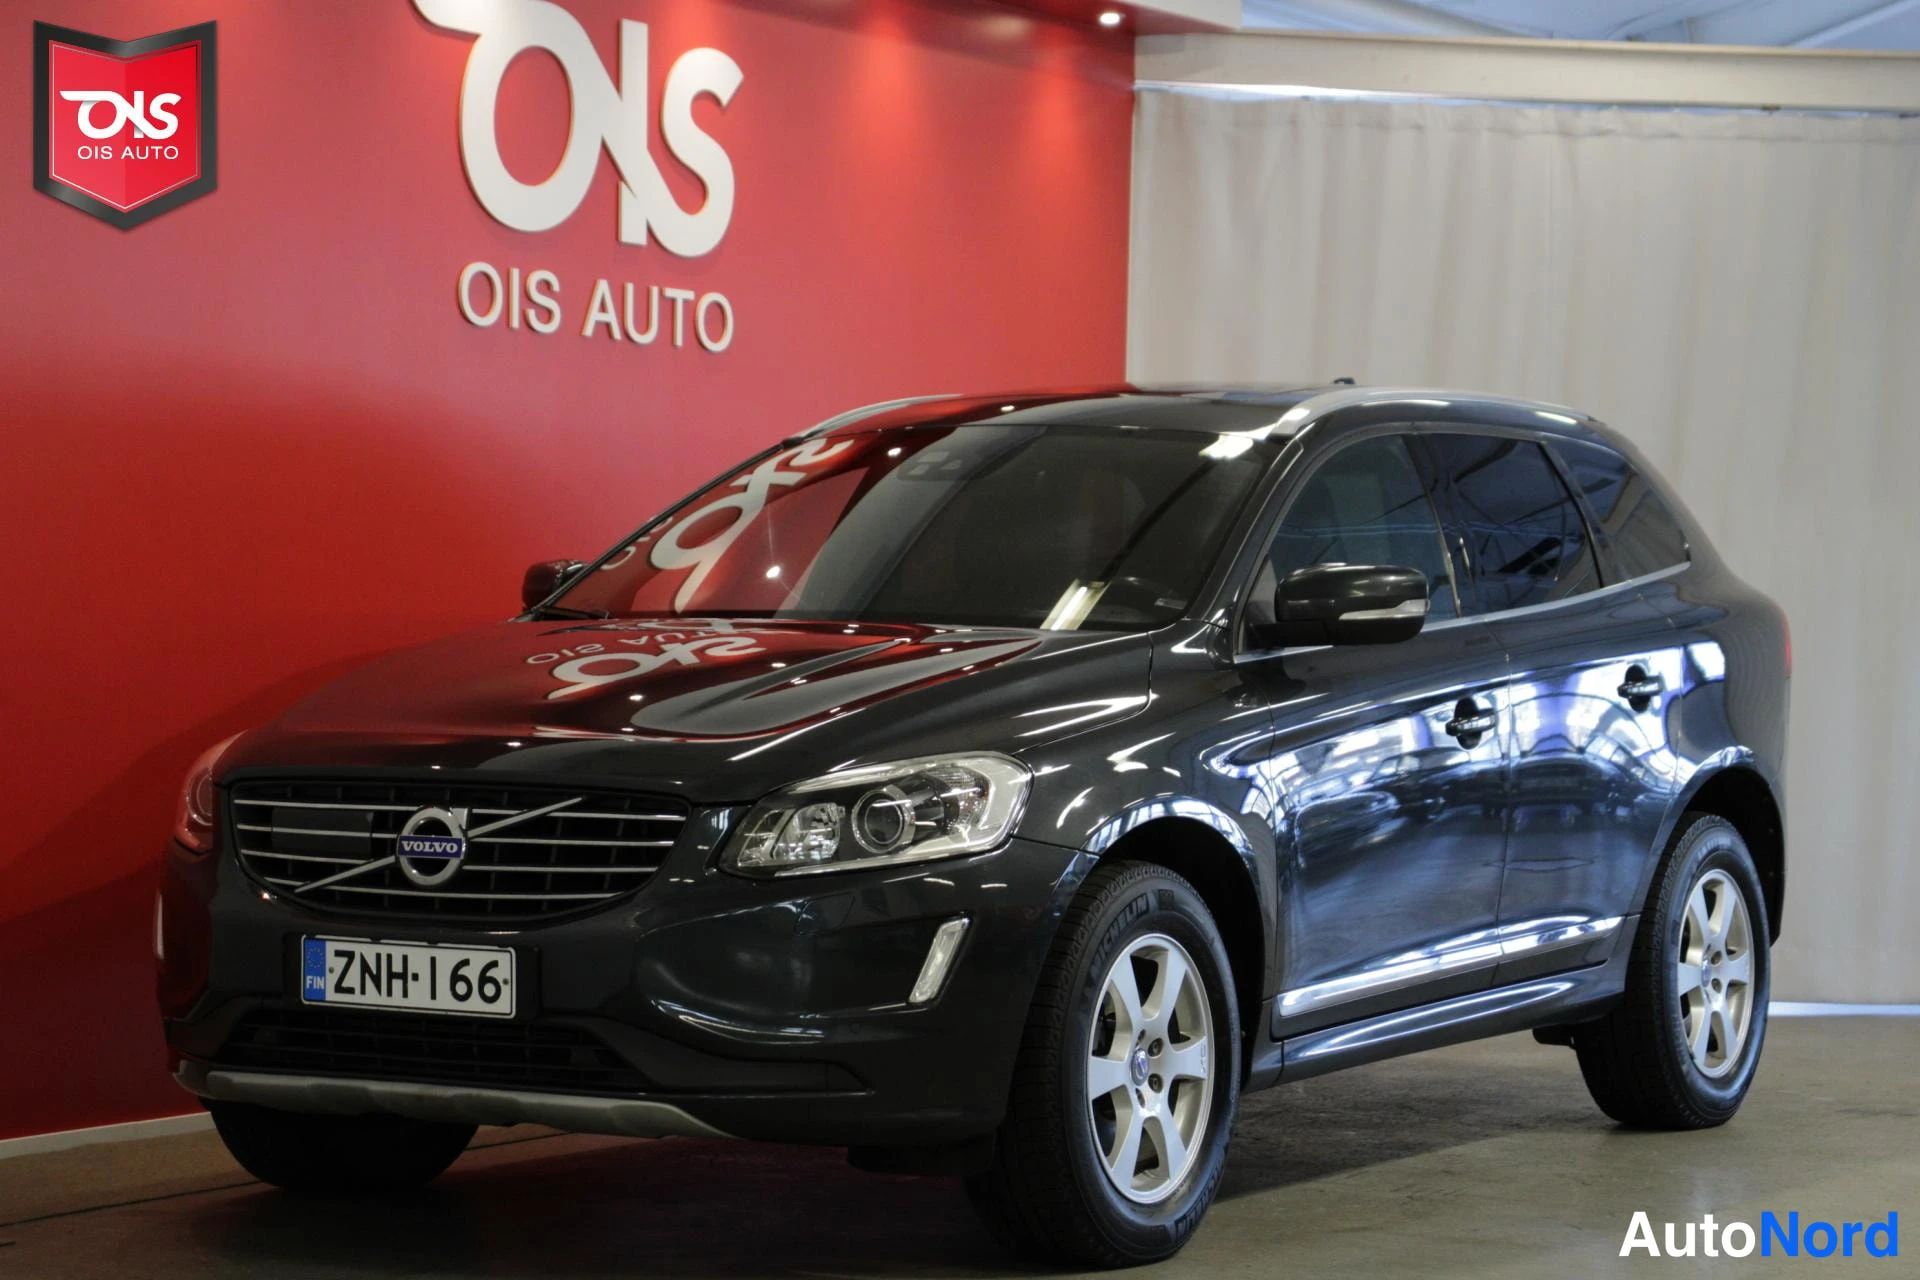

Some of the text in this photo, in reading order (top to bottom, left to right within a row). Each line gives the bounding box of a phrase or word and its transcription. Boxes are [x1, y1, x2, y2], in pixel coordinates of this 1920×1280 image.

[458, 261, 734, 353] OIS AUTO
[401, 840, 459, 854] VOLVO
[306, 975, 325, 989] FIN
[334, 949, 502, 1004] ZNH-166
